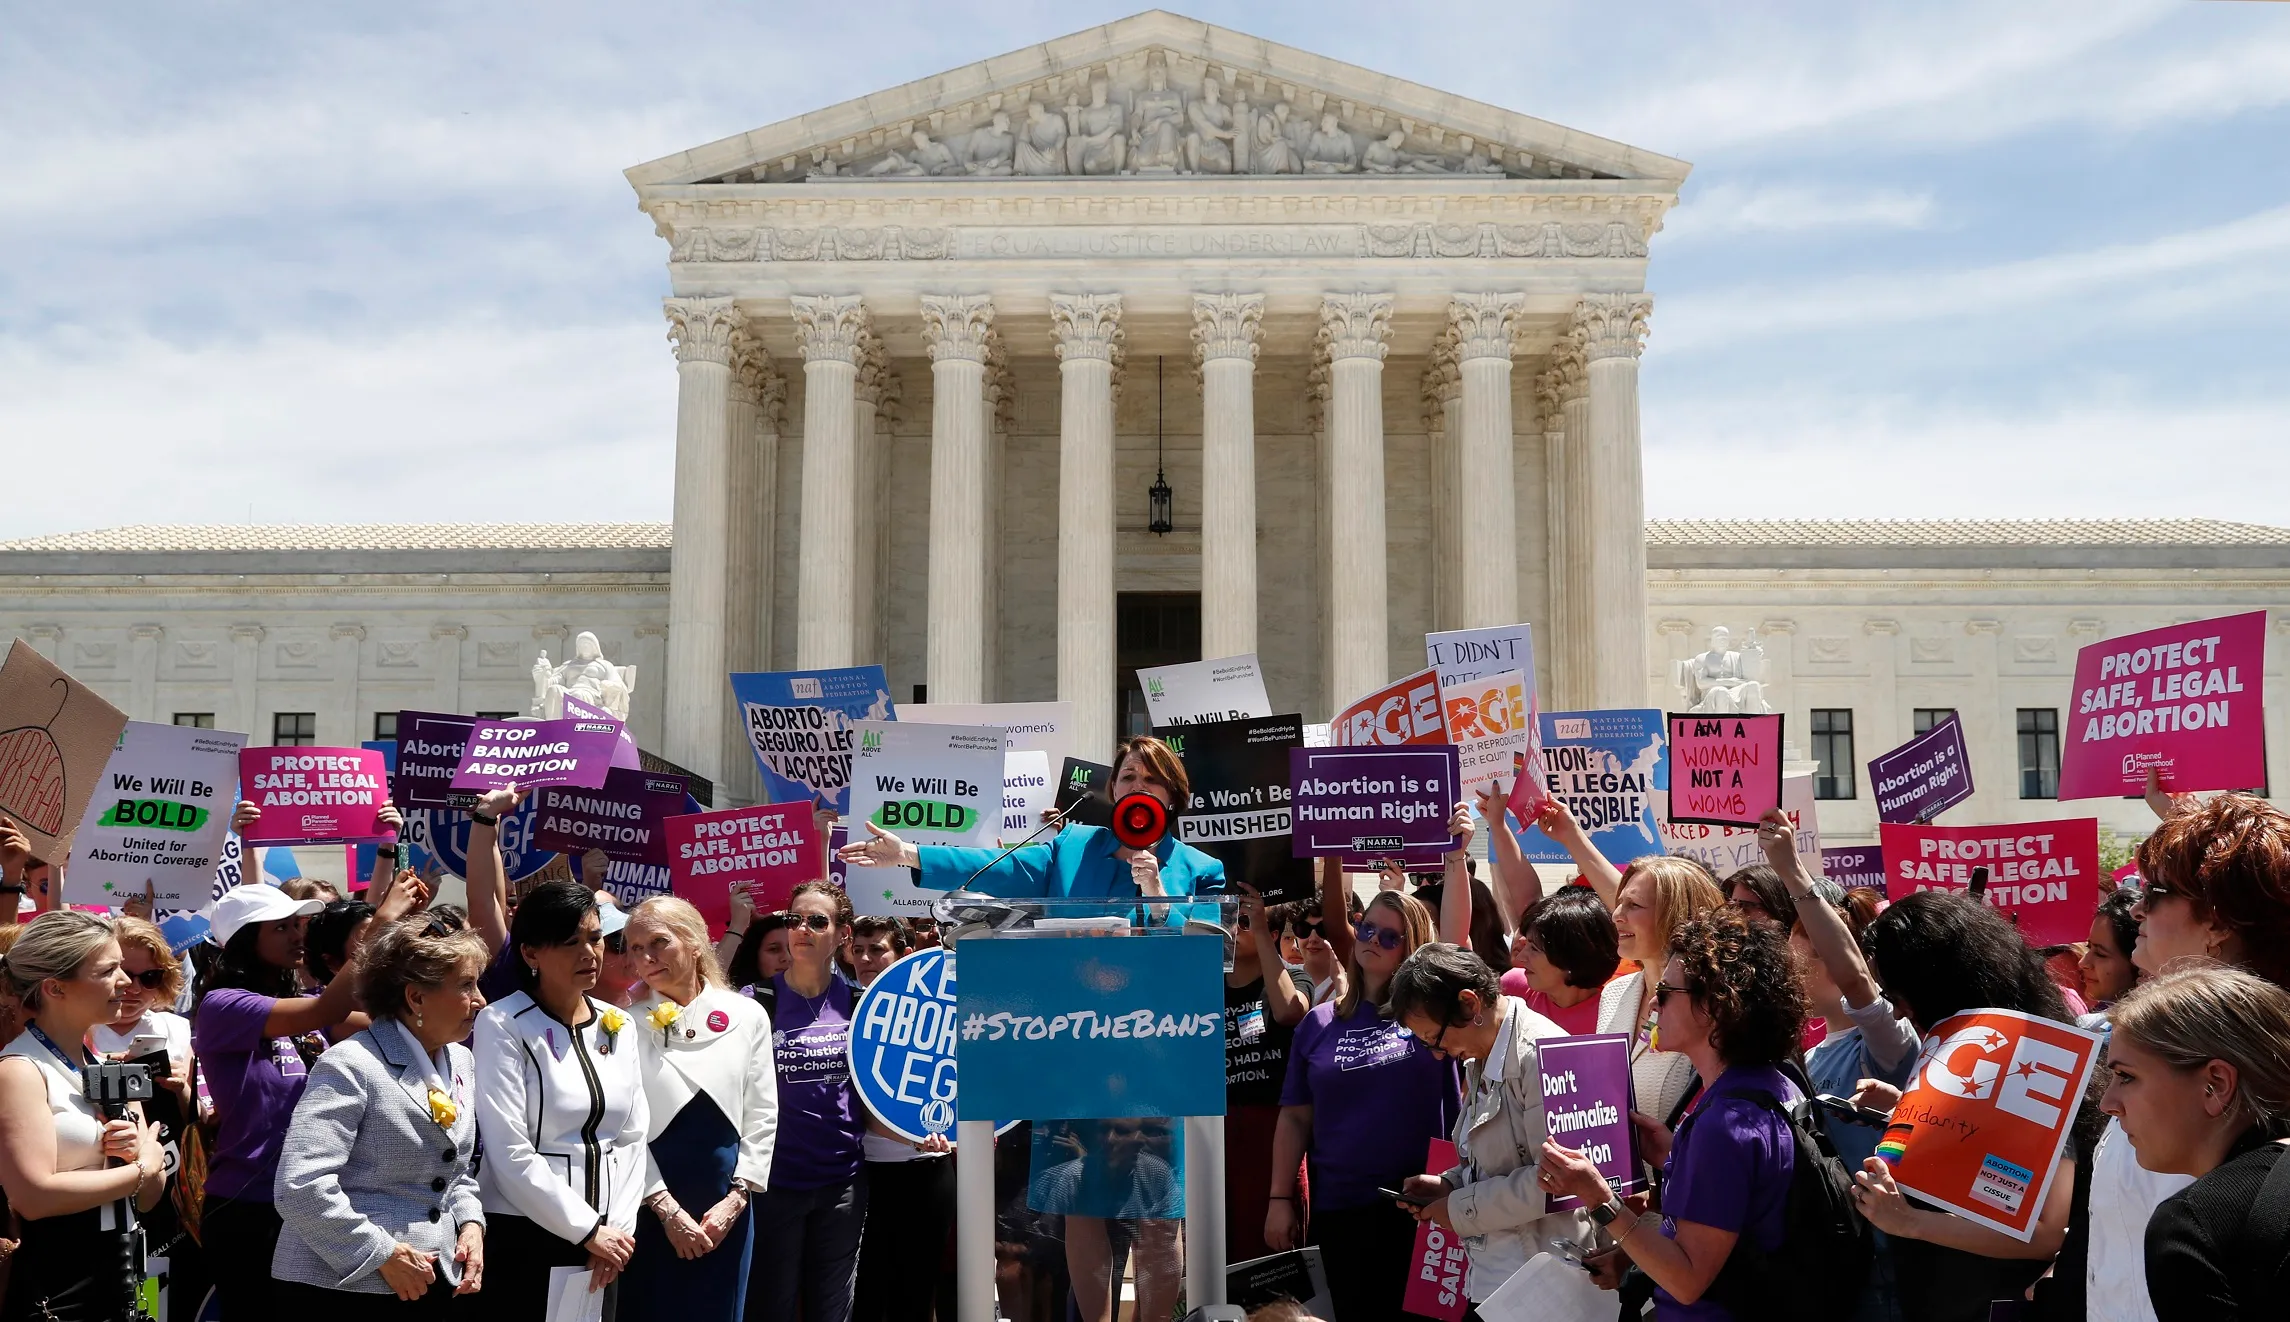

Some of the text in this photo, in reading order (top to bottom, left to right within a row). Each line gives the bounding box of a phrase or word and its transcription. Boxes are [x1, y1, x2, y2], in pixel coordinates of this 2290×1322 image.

[974, 233, 1341, 255] EQUAL JUSTICE UNDER LAW
[1454, 637, 1522, 665] DIDN'T
[2100, 636, 2221, 681] PROTECT
[794, 674, 866, 697] naf NATIONAL
[823, 681, 868, 691] ABORTION
[825, 689, 870, 698] FEDERATION
[2079, 666, 2244, 715] SAFE, LEGAL
[751, 706, 829, 730] ABORTO:
[1444, 684, 1525, 743] RGE
[2082, 700, 2229, 743] ABORTION
[479, 728, 537, 741] STOP
[1005, 722, 1055, 734] women's
[1247, 733, 1296, 744] #WontBePunished
[1248, 725, 1295, 735] #BeBoldEndHyde
[1560, 718, 1587, 738] naf
[1678, 721, 1684, 738] I
[1734, 721, 1746, 738] A
[402, 739, 466, 758] Aborti
[472, 742, 570, 759] BANNING
[755, 730, 854, 754] SEGURO, LEG
[948, 743, 998, 751] #WontBePunished
[950, 735, 998, 744] #BeBoldEndHyde
[1459, 733, 1525, 756] OR REPRODUCTIVE
[271, 755, 362, 772] PROTECT
[768, 754, 779, 773] Y
[1480, 750, 1508, 765] EQUITY
[1681, 743, 1758, 769] WOMAN
[2136, 751, 2162, 760] Planned
[401, 761, 457, 779] Huma
[465, 758, 578, 777] ABORTION
[1878, 744, 1955, 796] Abortion is a
[113, 773, 213, 798] We Will Be
[253, 773, 379, 790] SAFE, LEGAL
[656, 781, 680, 792] NARAL
[875, 775, 979, 797] We Will Be
[1069, 781, 1087, 789] ABOVE
[1298, 774, 1439, 796] Abortion is a
[1691, 769, 1744, 789] NOT A
[1881, 762, 1959, 813] Human Right
[262, 790, 373, 806] ABORTION
[547, 791, 642, 820] BANNING
[1210, 784, 1291, 808] Won't Be
[1687, 793, 1746, 816] WOMB
[1926, 800, 1944, 814] NARAL
[114, 799, 198, 828] BOLD
[881, 800, 965, 828] BOLD
[1003, 814, 1027, 829] All!
[1299, 800, 1440, 824] Human Right
[543, 816, 651, 844] ABORTION
[694, 813, 785, 839] PROTECT
[1182, 813, 1291, 838] PUNISHED
[122, 837, 187, 852] United for
[680, 830, 804, 859] SAFE, LEGAL
[1366, 838, 1401, 846] NARAL
[1919, 834, 2054, 860] PROTECT
[88, 848, 209, 868] Abortion Coverage
[690, 849, 798, 876] ABORTION
[1822, 854, 1866, 869] STOP
[1899, 856, 2080, 884] SAFE LEGAL
[777, 1045, 848, 1059] Pro-Justice.
[1234, 1051, 1261, 1066] HAD
[1262, 1048, 1282, 1061] AN
[777, 1059, 847, 1073] Pro-Choice.
[871, 1045, 957, 1106] LEG
[1542, 1070, 1578, 1097] Don't
[1547, 1099, 1618, 1135] Criminalize
[1894, 1100, 1980, 1143] Solidarity
[1980, 1169, 1997, 1181] NOT
[1997, 1177, 2018, 1190] JUST
[1986, 1158, 2030, 1181] ABORTION:
[1983, 1186, 2012, 1202] CISSUE
[1438, 1246, 1465, 1308] SAFE
